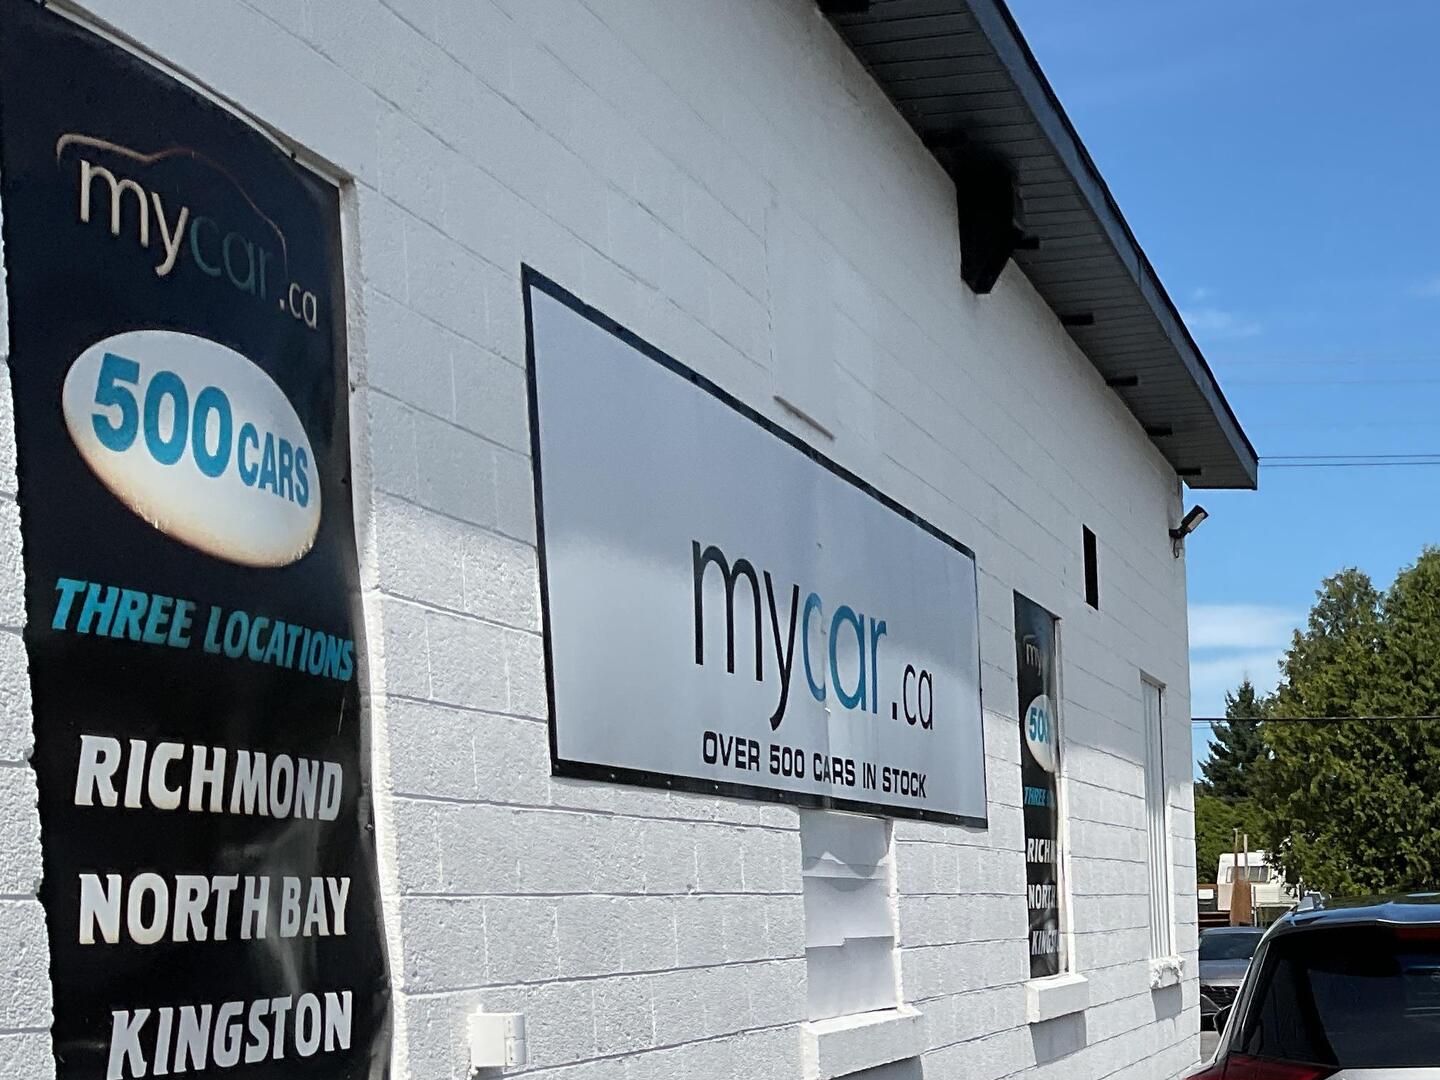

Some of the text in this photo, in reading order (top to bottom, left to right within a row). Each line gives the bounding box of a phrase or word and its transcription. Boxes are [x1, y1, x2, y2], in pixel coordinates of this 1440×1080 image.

[91, 353, 310, 507] 500 CARS
[52, 577, 354, 682] THREE LOCATIONS
[74, 735, 344, 822] RICHMOND
[702, 730, 927, 798] OVER 500 CARS IN STOCK
[78, 872, 351, 945] NORTH BAY
[106, 990, 353, 1080] KINGSTON
